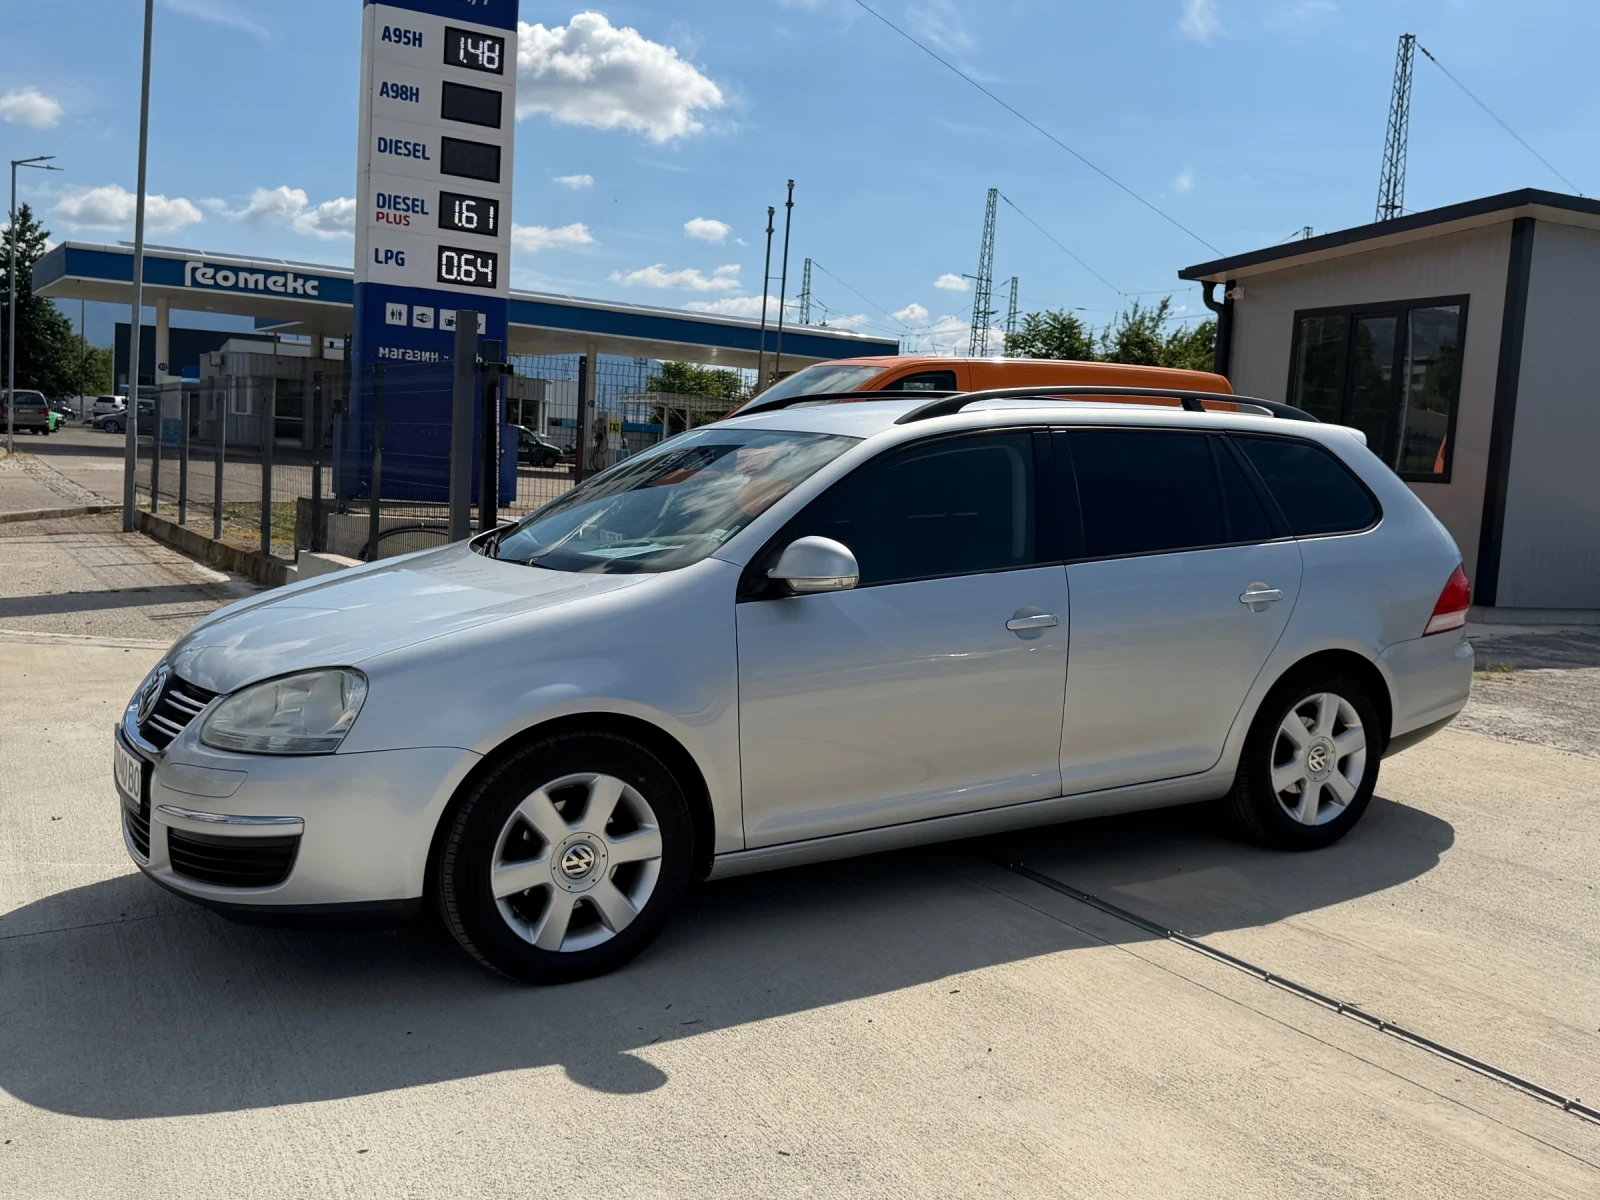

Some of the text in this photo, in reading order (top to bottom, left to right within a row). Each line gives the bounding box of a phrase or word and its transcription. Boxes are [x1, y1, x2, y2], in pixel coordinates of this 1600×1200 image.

[381, 25, 423, 48] A95H
[379, 81, 420, 103] A98H
[377, 136, 431, 160] DIESEL
[376, 192, 429, 215] DIESEL
[375, 211, 411, 226] PLUS
[374, 247, 405, 267] LPG
[441, 251, 493, 282] 0.64
